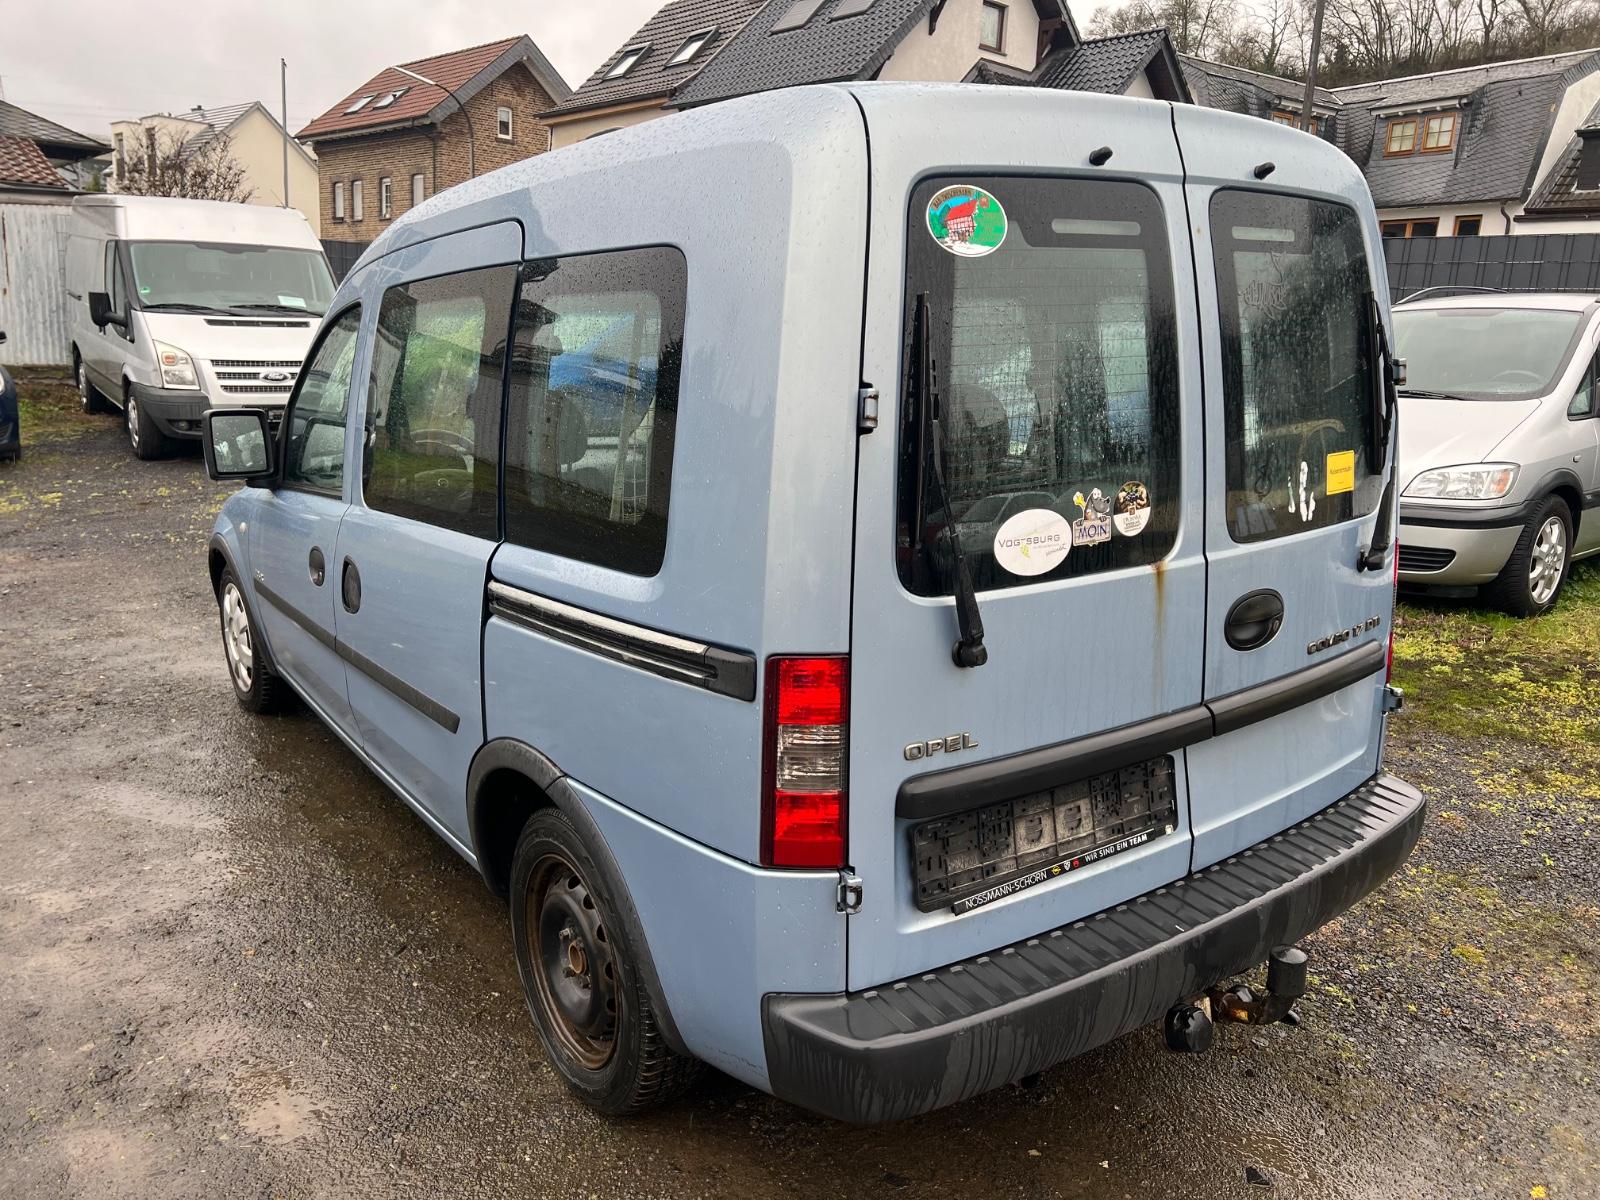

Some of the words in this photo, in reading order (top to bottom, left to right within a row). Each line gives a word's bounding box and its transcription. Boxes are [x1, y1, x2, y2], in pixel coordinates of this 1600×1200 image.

[1079, 524, 1107, 539] MOIN
[904, 733, 978, 760] OPEL
[965, 871, 1047, 909] NOSSMANN-SCHORN
[1084, 852, 1098, 863] WIR
[1099, 847, 1115, 859] SIND
[1116, 841, 1128, 851] EIN
[1129, 834, 1148, 847] TEAM
